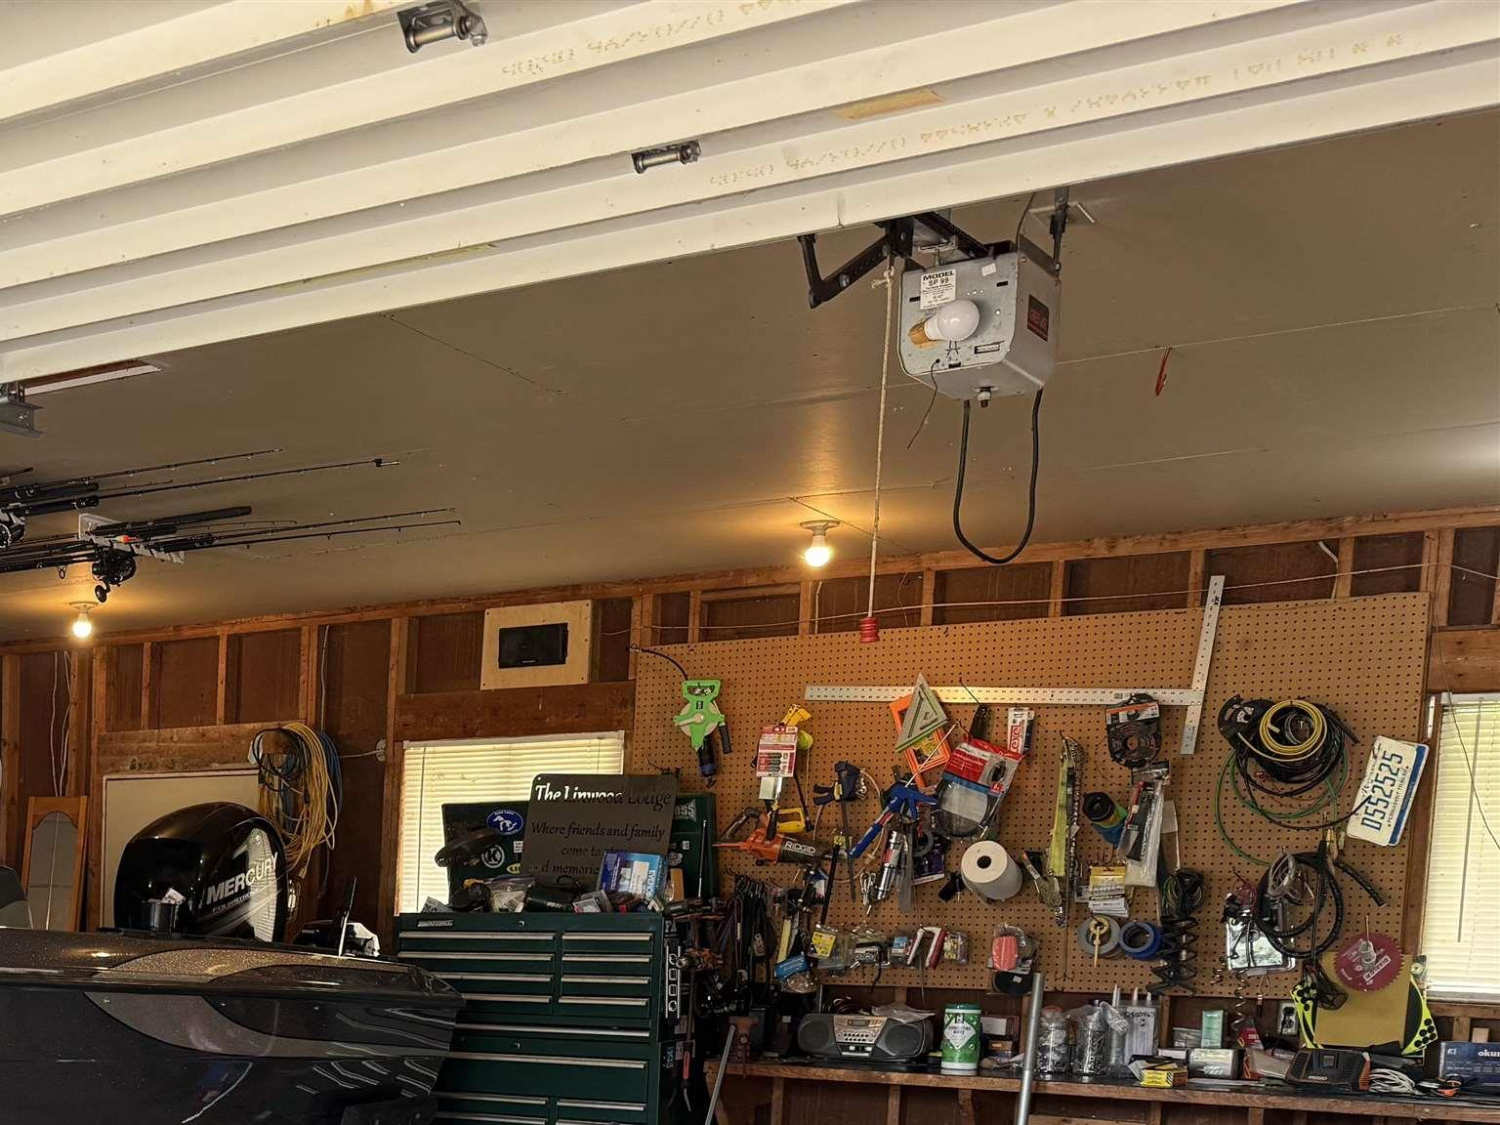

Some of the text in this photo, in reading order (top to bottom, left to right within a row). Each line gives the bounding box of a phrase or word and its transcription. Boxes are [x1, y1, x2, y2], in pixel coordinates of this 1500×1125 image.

[923, 270, 954, 281] MODEL
[535, 783, 561, 803] The
[563, 784, 624, 805] Linwood
[1361, 750, 1403, 832] D552525
[531, 821, 666, 841] Where friends and family
[785, 841, 816, 854] RIDGID
[206, 851, 278, 905] MERCURY
[552, 863, 600, 875] memorie
